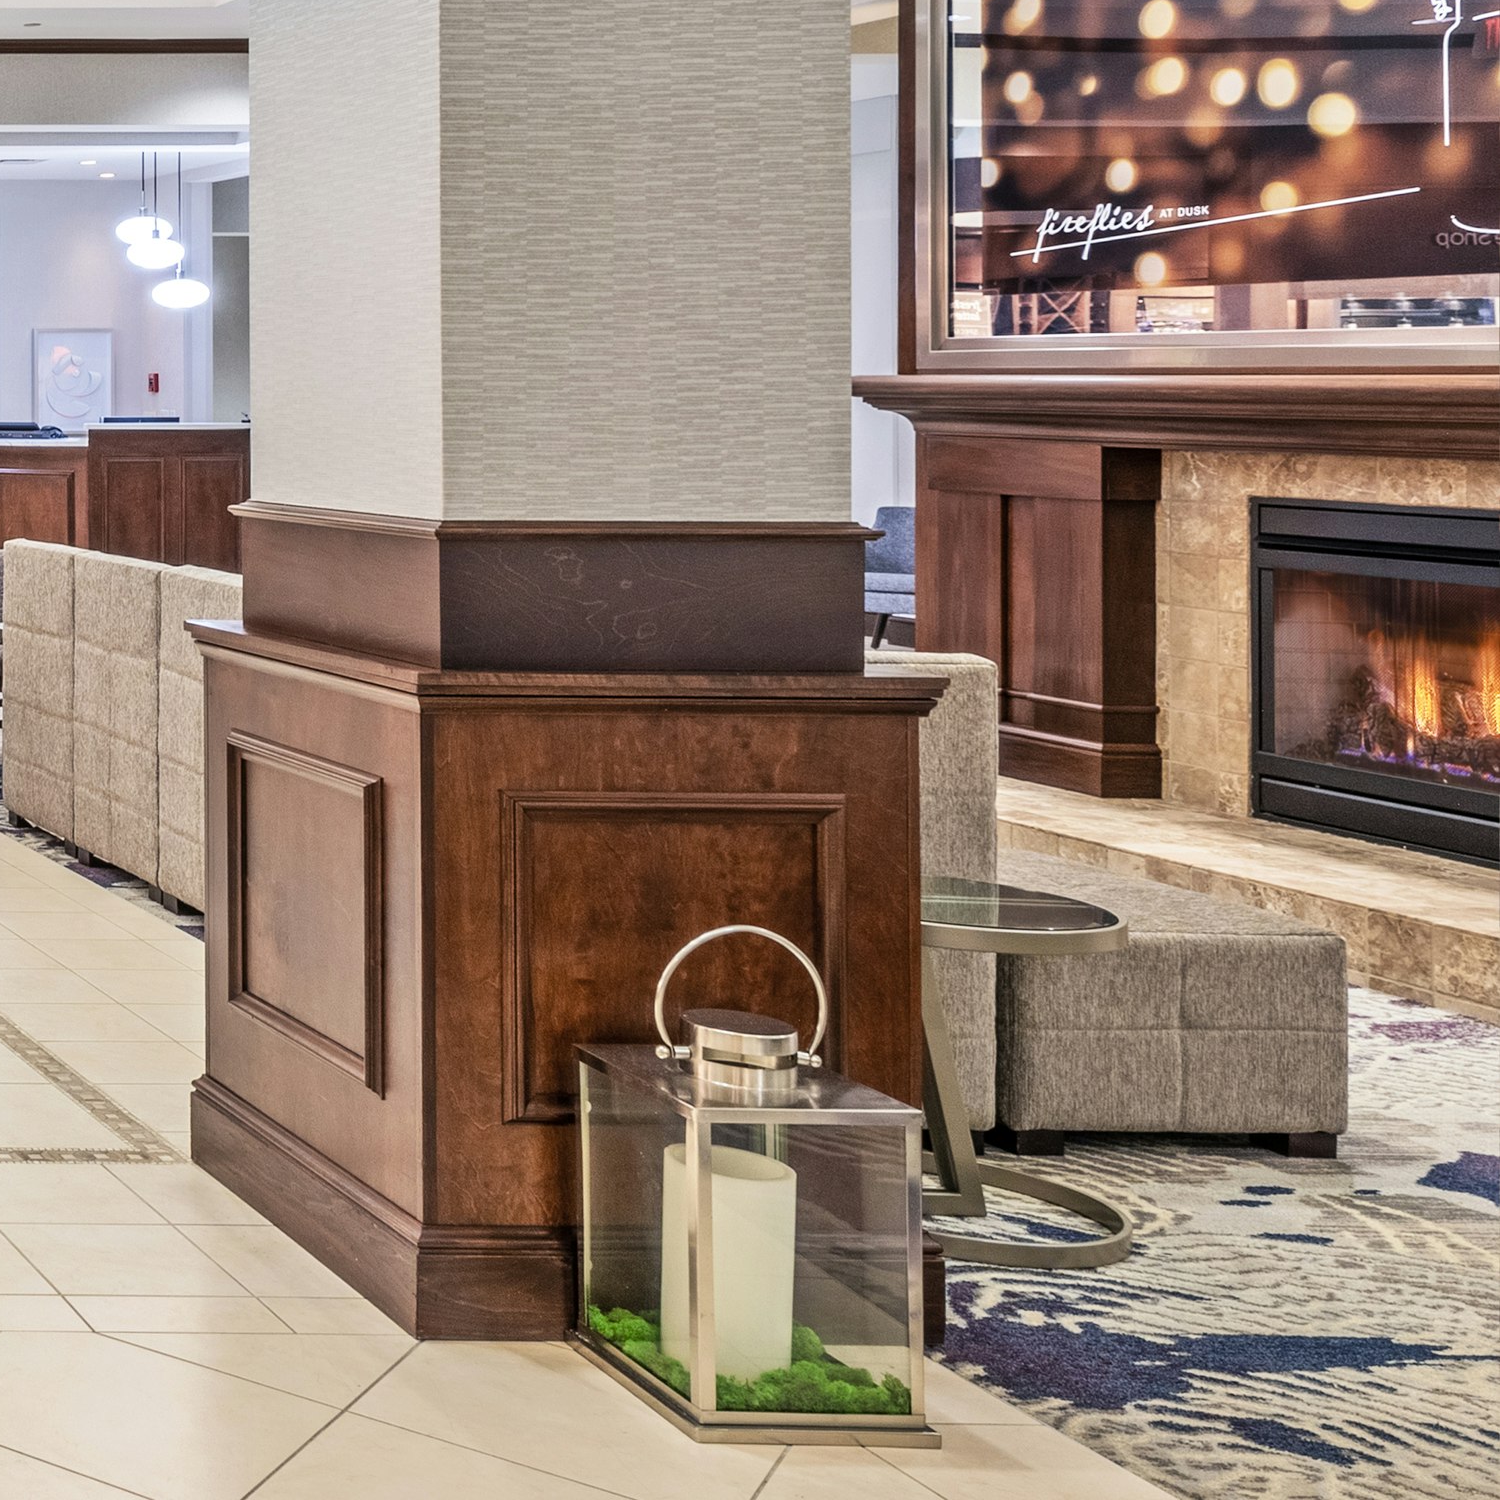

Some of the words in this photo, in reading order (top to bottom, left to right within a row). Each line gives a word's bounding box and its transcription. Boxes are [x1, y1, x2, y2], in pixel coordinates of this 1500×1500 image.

[1033, 203, 1155, 264] fireflies
[1159, 208, 1174, 219] AT
[1177, 205, 1210, 218] DUSK
